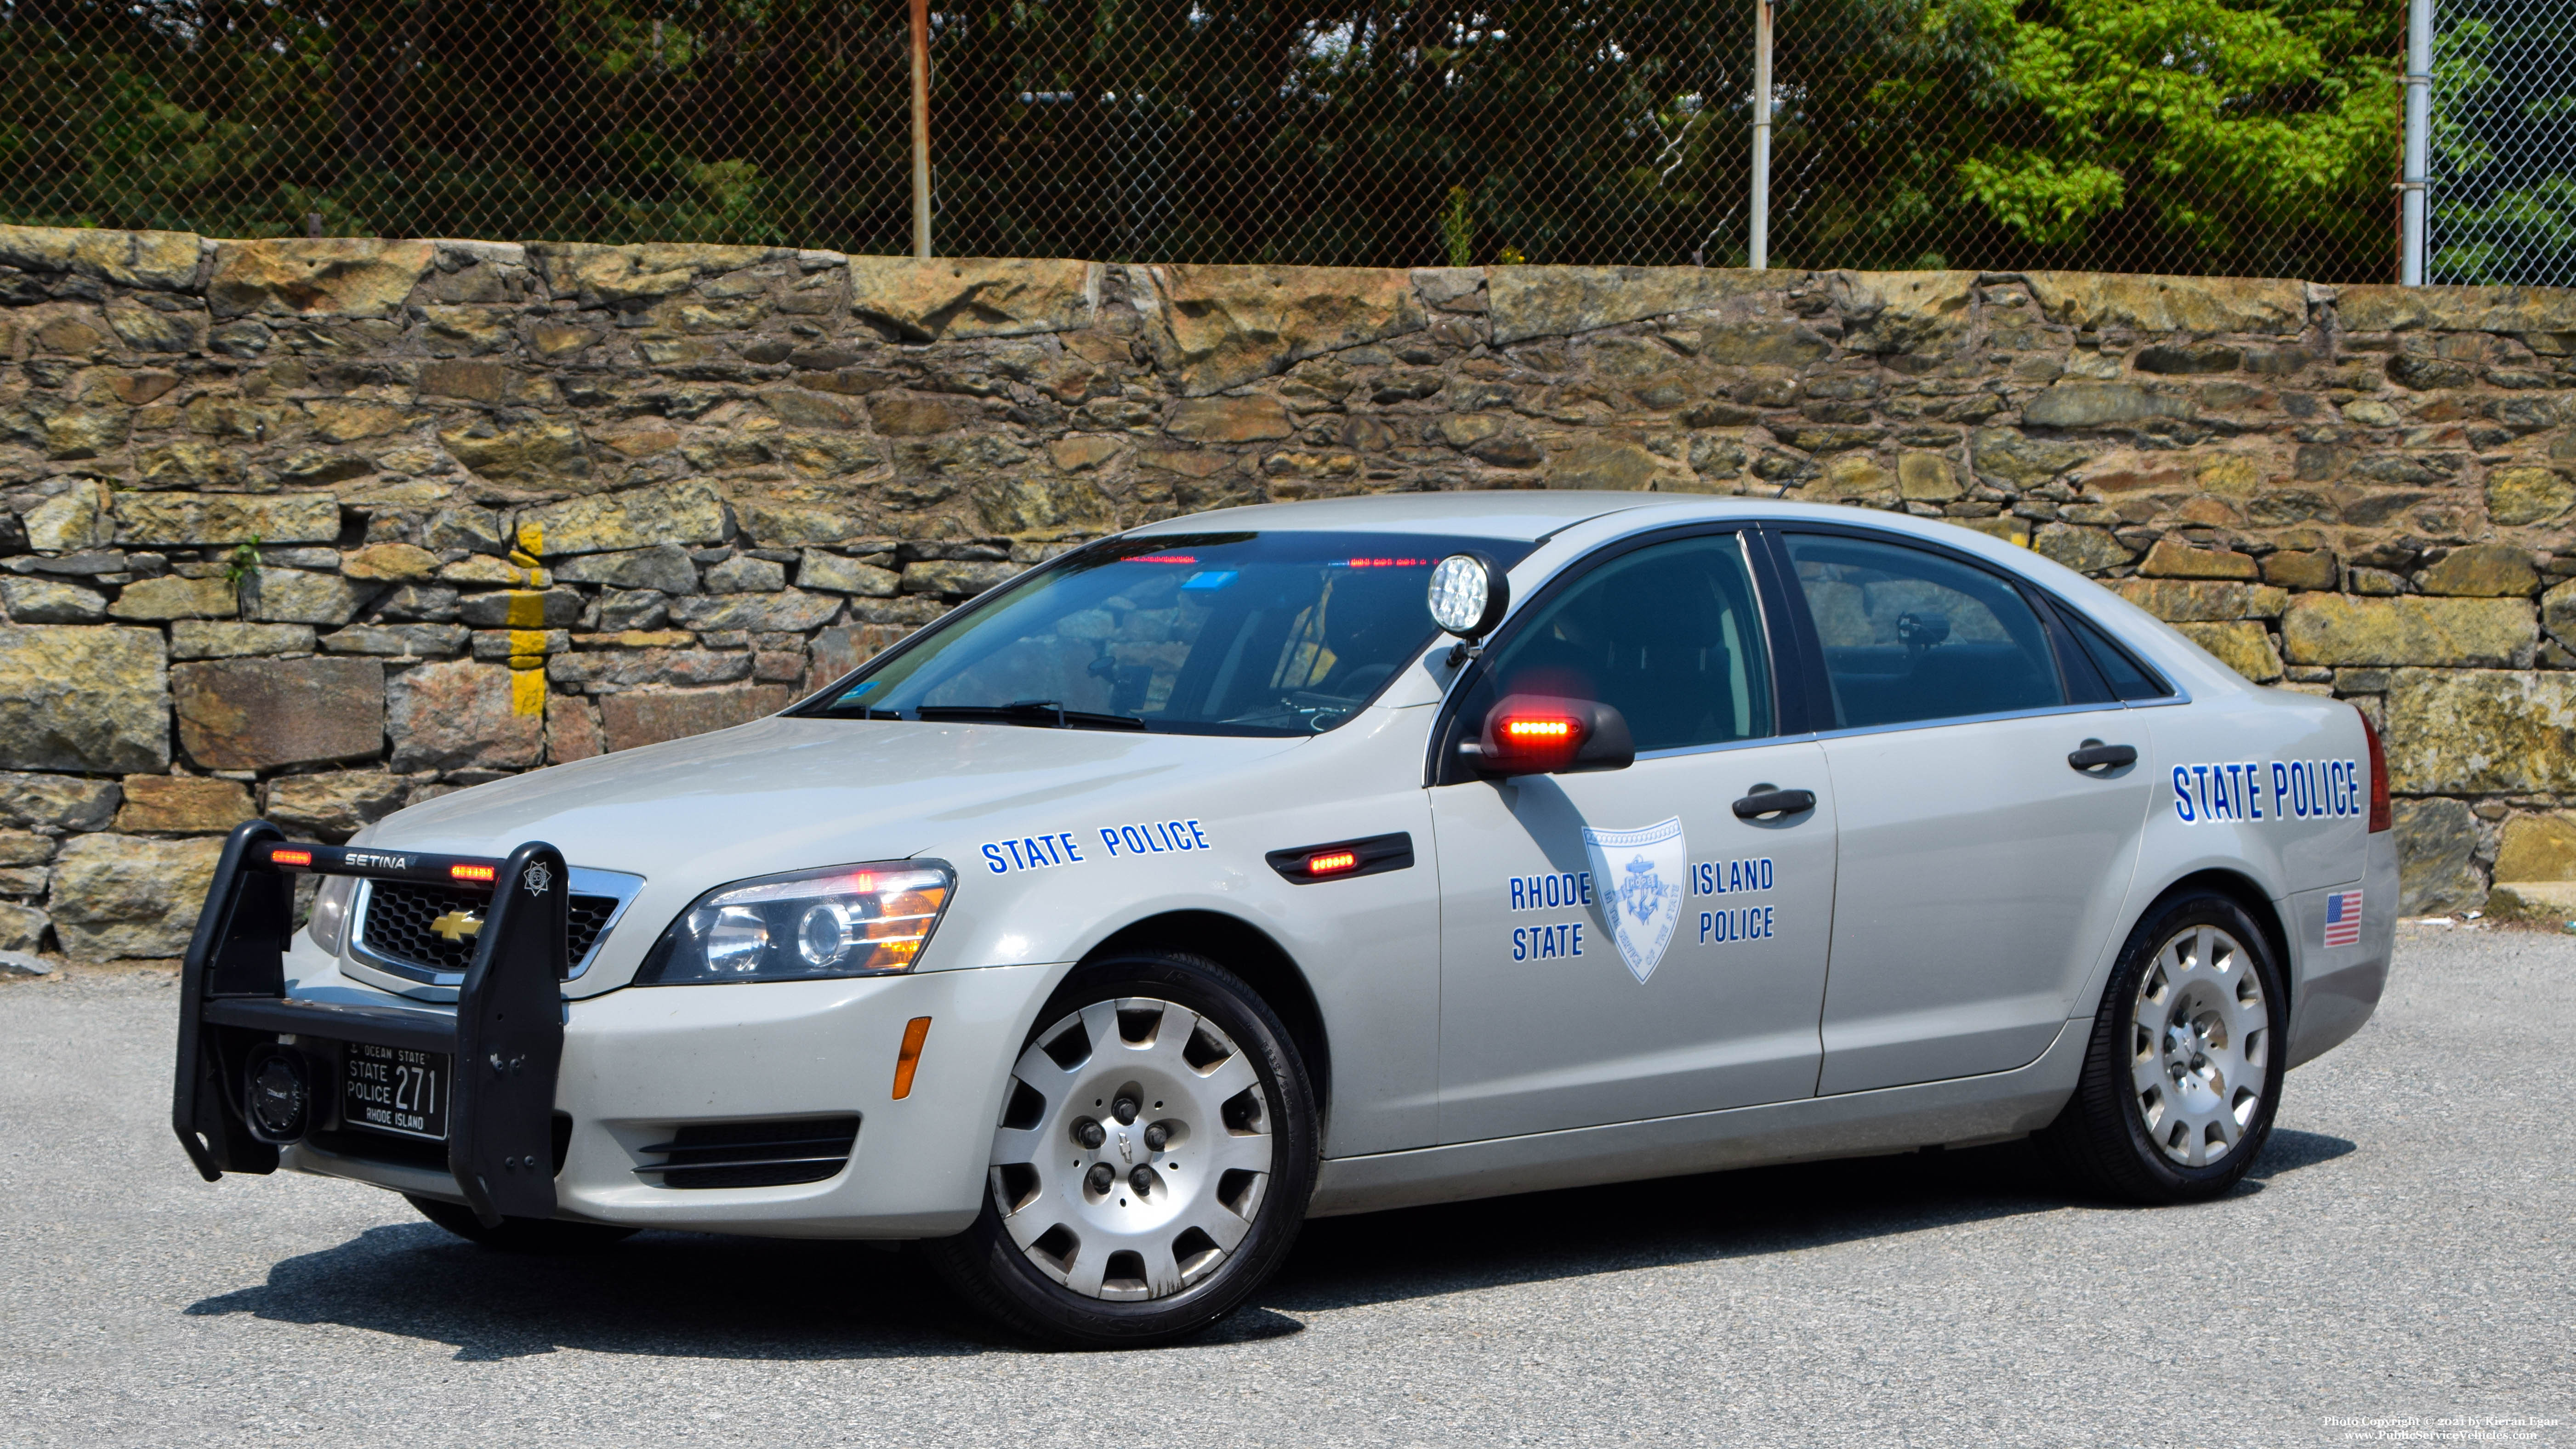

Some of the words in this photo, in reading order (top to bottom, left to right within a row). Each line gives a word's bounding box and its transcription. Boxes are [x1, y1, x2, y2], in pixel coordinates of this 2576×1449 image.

[2172, 762, 2263, 826] STATE
[2270, 758, 2360, 822] POLICE
[979, 831, 1086, 875] STATE
[1098, 818, 1211, 858] POLICE
[345, 853, 406, 870] SETINA
[1509, 871, 1592, 911] RHODE
[1691, 858, 1774, 897] ISLAND
[1631, 877, 1653, 886] HOPE
[1512, 922, 1584, 963] STATE
[1699, 904, 1775, 946] POLICE
[364, 1045, 392, 1059] OCEAN
[398, 1050, 425, 1065] STATE
[349, 1060, 387, 1082] STATE
[347, 1081, 391, 1104] POLICE
[396, 1065, 435, 1114] 271
[366, 1107, 392, 1124] RHODE
[395, 1112, 423, 1131] ISLAND
